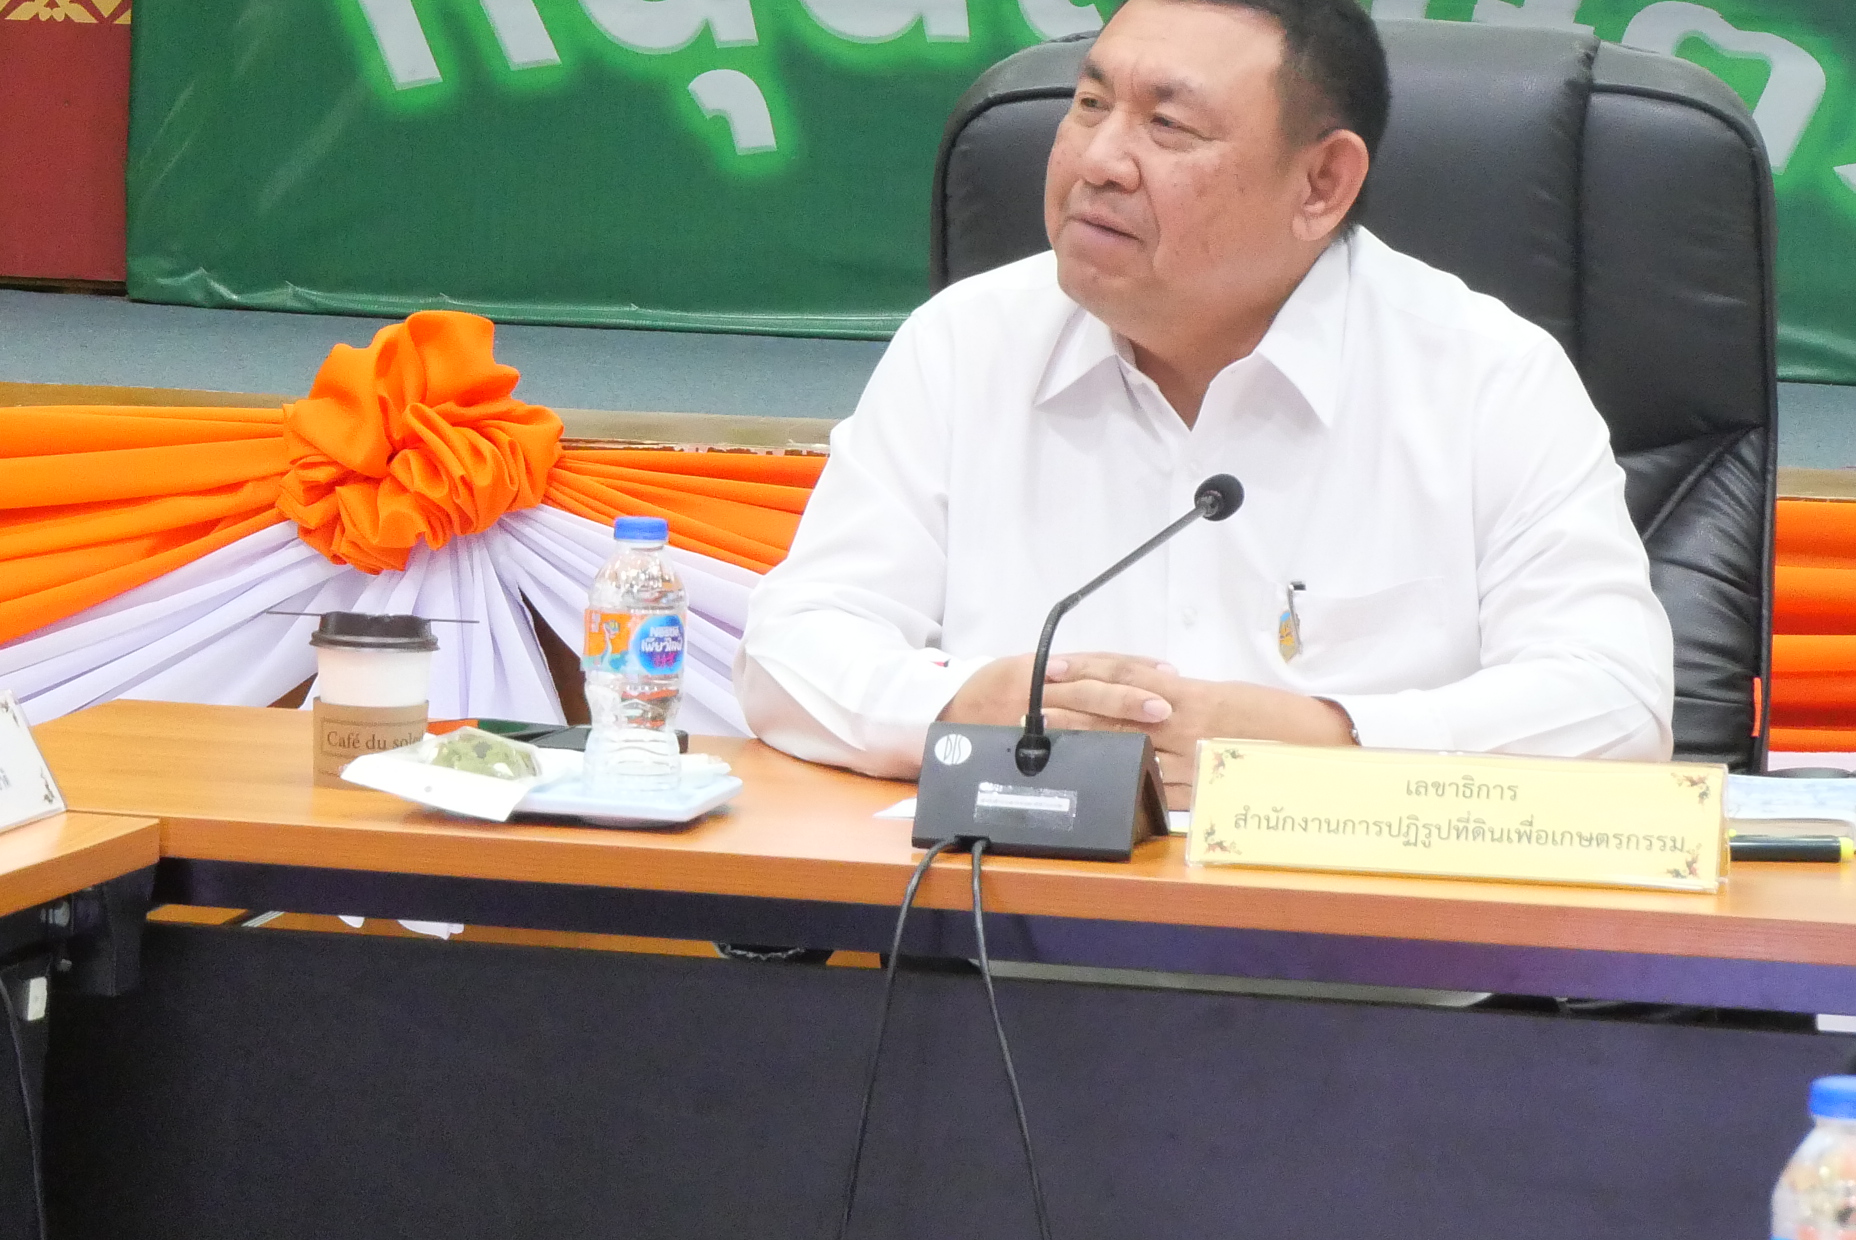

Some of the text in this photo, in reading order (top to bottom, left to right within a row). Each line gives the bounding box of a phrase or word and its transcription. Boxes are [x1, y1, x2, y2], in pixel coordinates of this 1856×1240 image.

[327, 730, 362, 749] Café
[365, 733, 387, 750] du
[1405, 773, 1518, 801] เลขาธิการ
[1233, 806, 1686, 854] สำนักงานการปฏิรูปที่ดินเพื่อเกษตรกรรม
